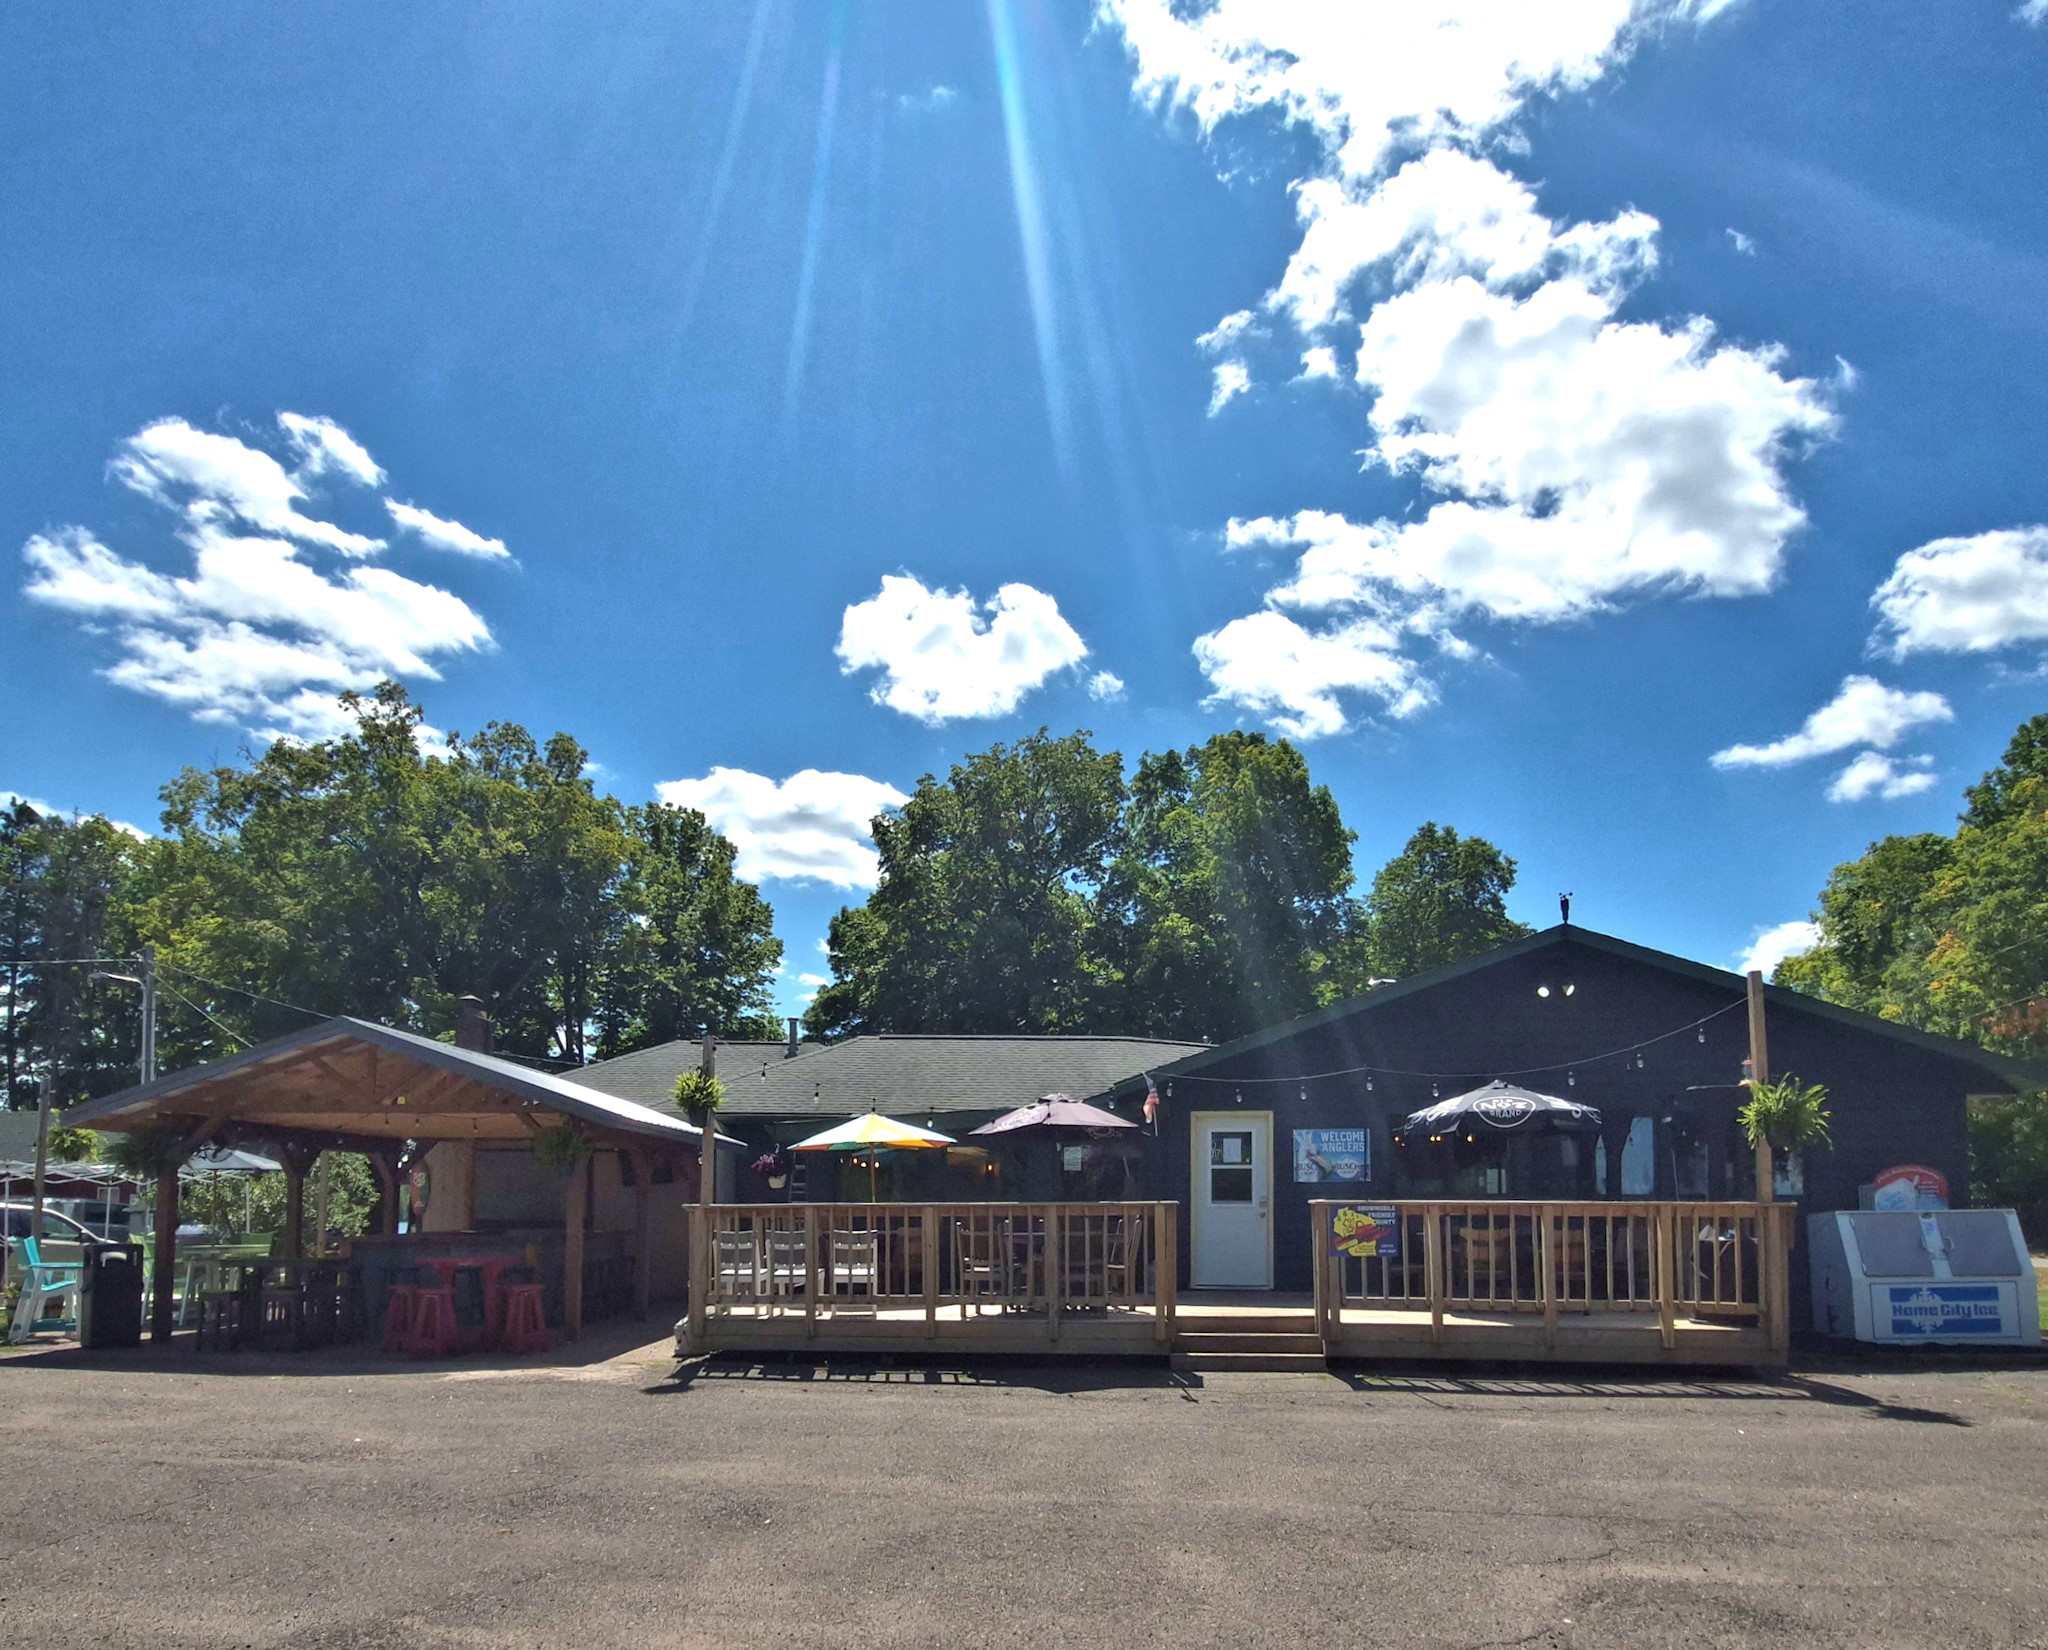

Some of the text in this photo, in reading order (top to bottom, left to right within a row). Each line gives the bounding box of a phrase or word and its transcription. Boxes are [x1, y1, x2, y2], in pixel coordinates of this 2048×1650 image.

[1489, 1109, 1523, 1118] BRAND
[1321, 1131, 1365, 1142] WELCOME
[1321, 1142, 1365, 1152] ANGLERS
[1893, 1303, 1998, 1318] Home City Ice
